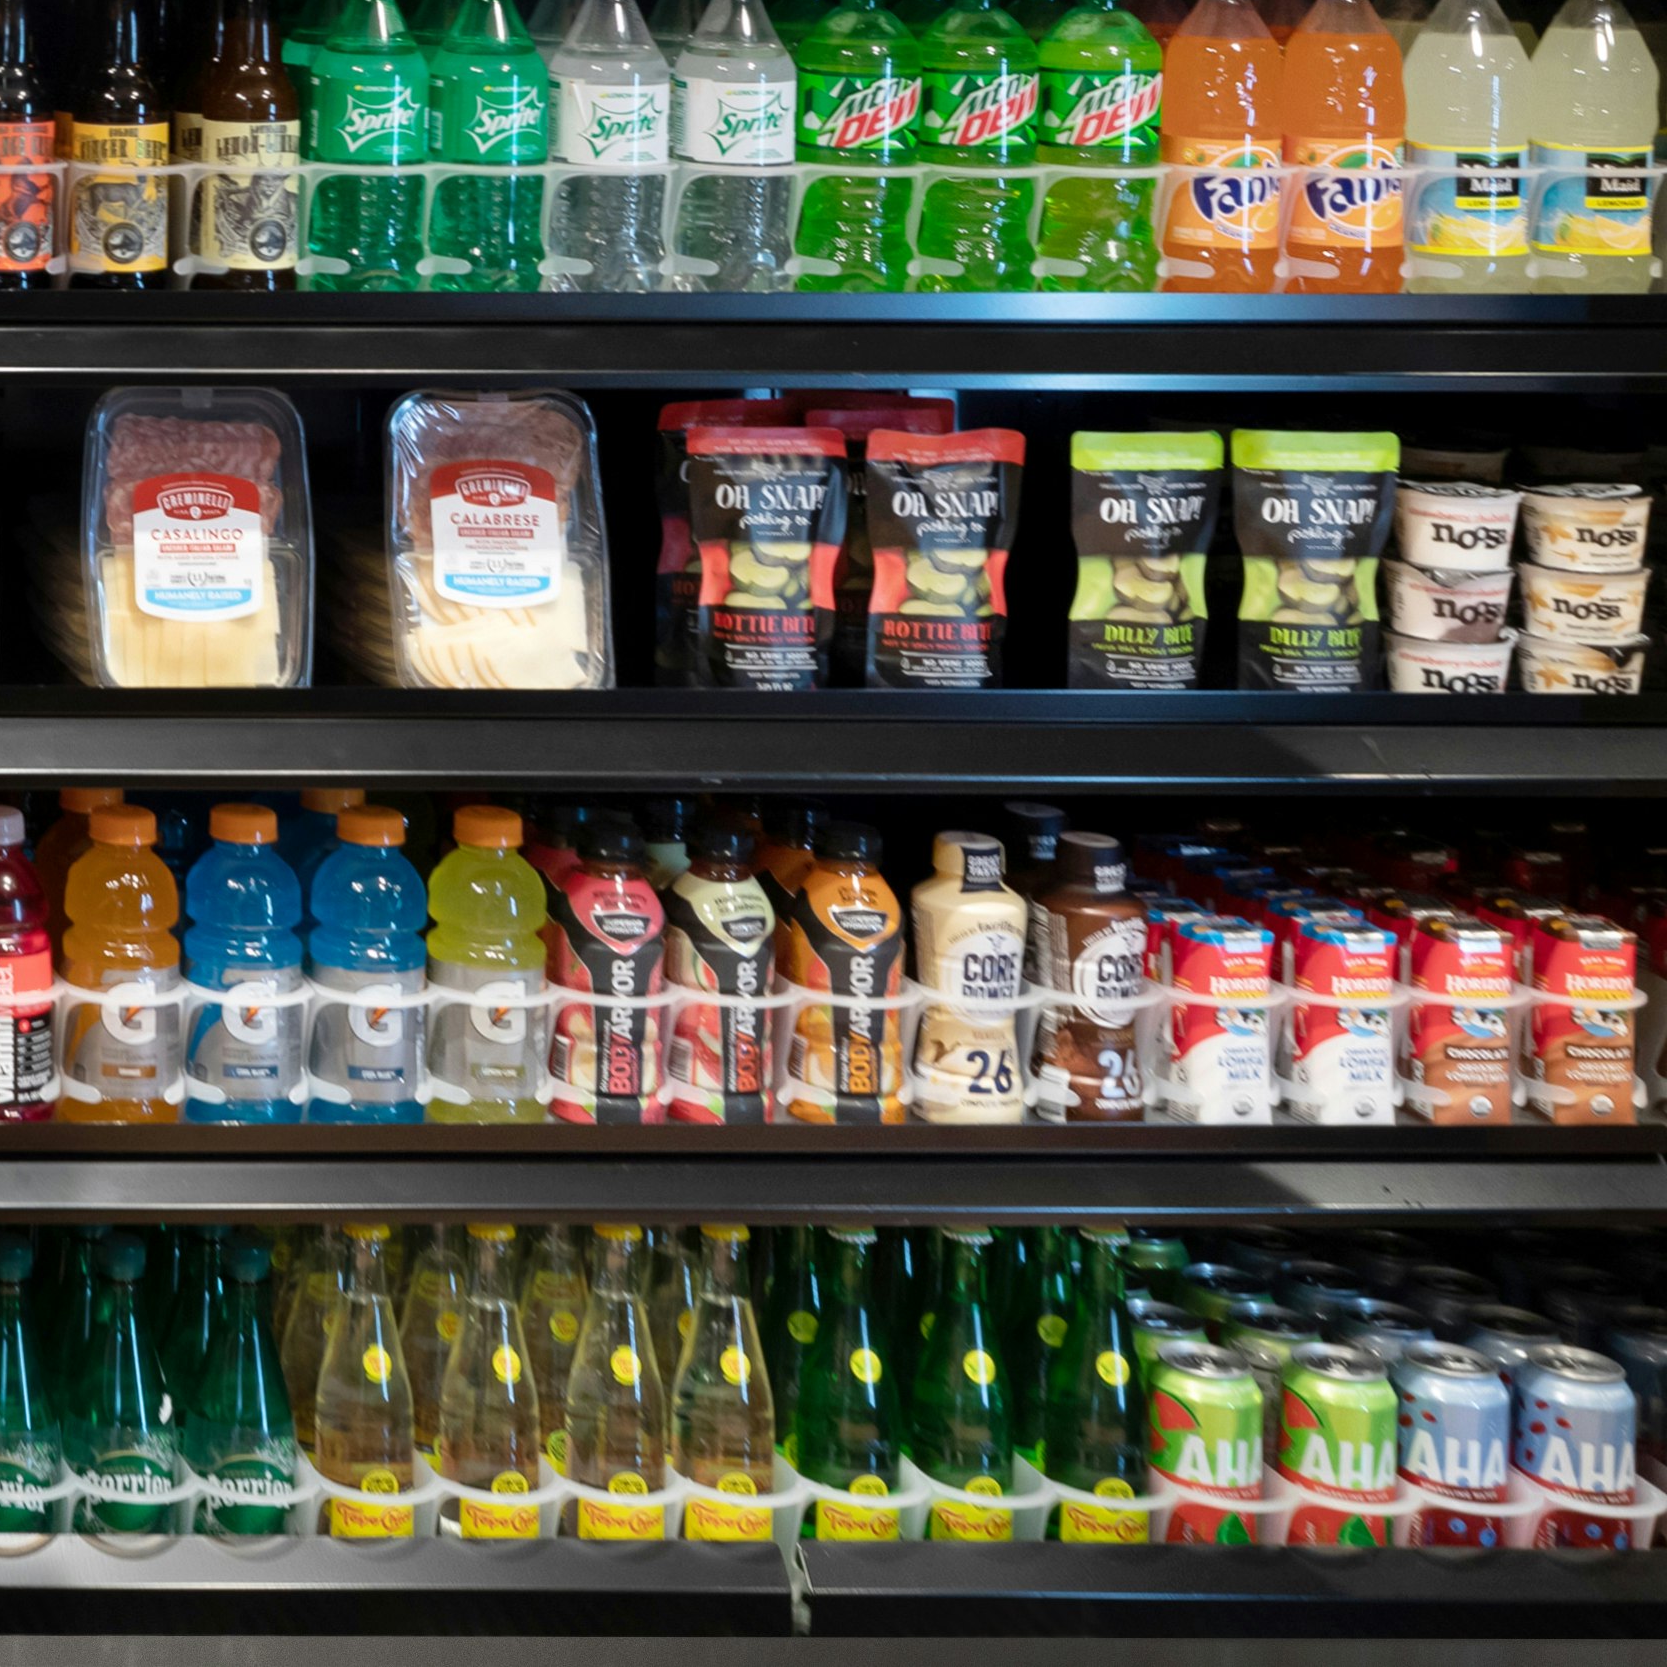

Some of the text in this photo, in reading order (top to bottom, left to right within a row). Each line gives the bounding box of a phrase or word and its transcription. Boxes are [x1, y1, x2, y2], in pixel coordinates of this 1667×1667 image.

[347, 103, 415, 135] Sprite
[475, 103, 543, 135] Sprite
[591, 112, 658, 140] Sprite
[150, 527, 244, 542] CASALINGO
[449, 512, 541, 527] CALABRESE
[964, 953, 1017, 981] CORE
[966, 1050, 1013, 1094] 26
[1298, 1435, 1397, 1492] AHA
[1405, 1430, 1508, 1494] AHA
[1536, 1434, 1635, 1496] AHA
